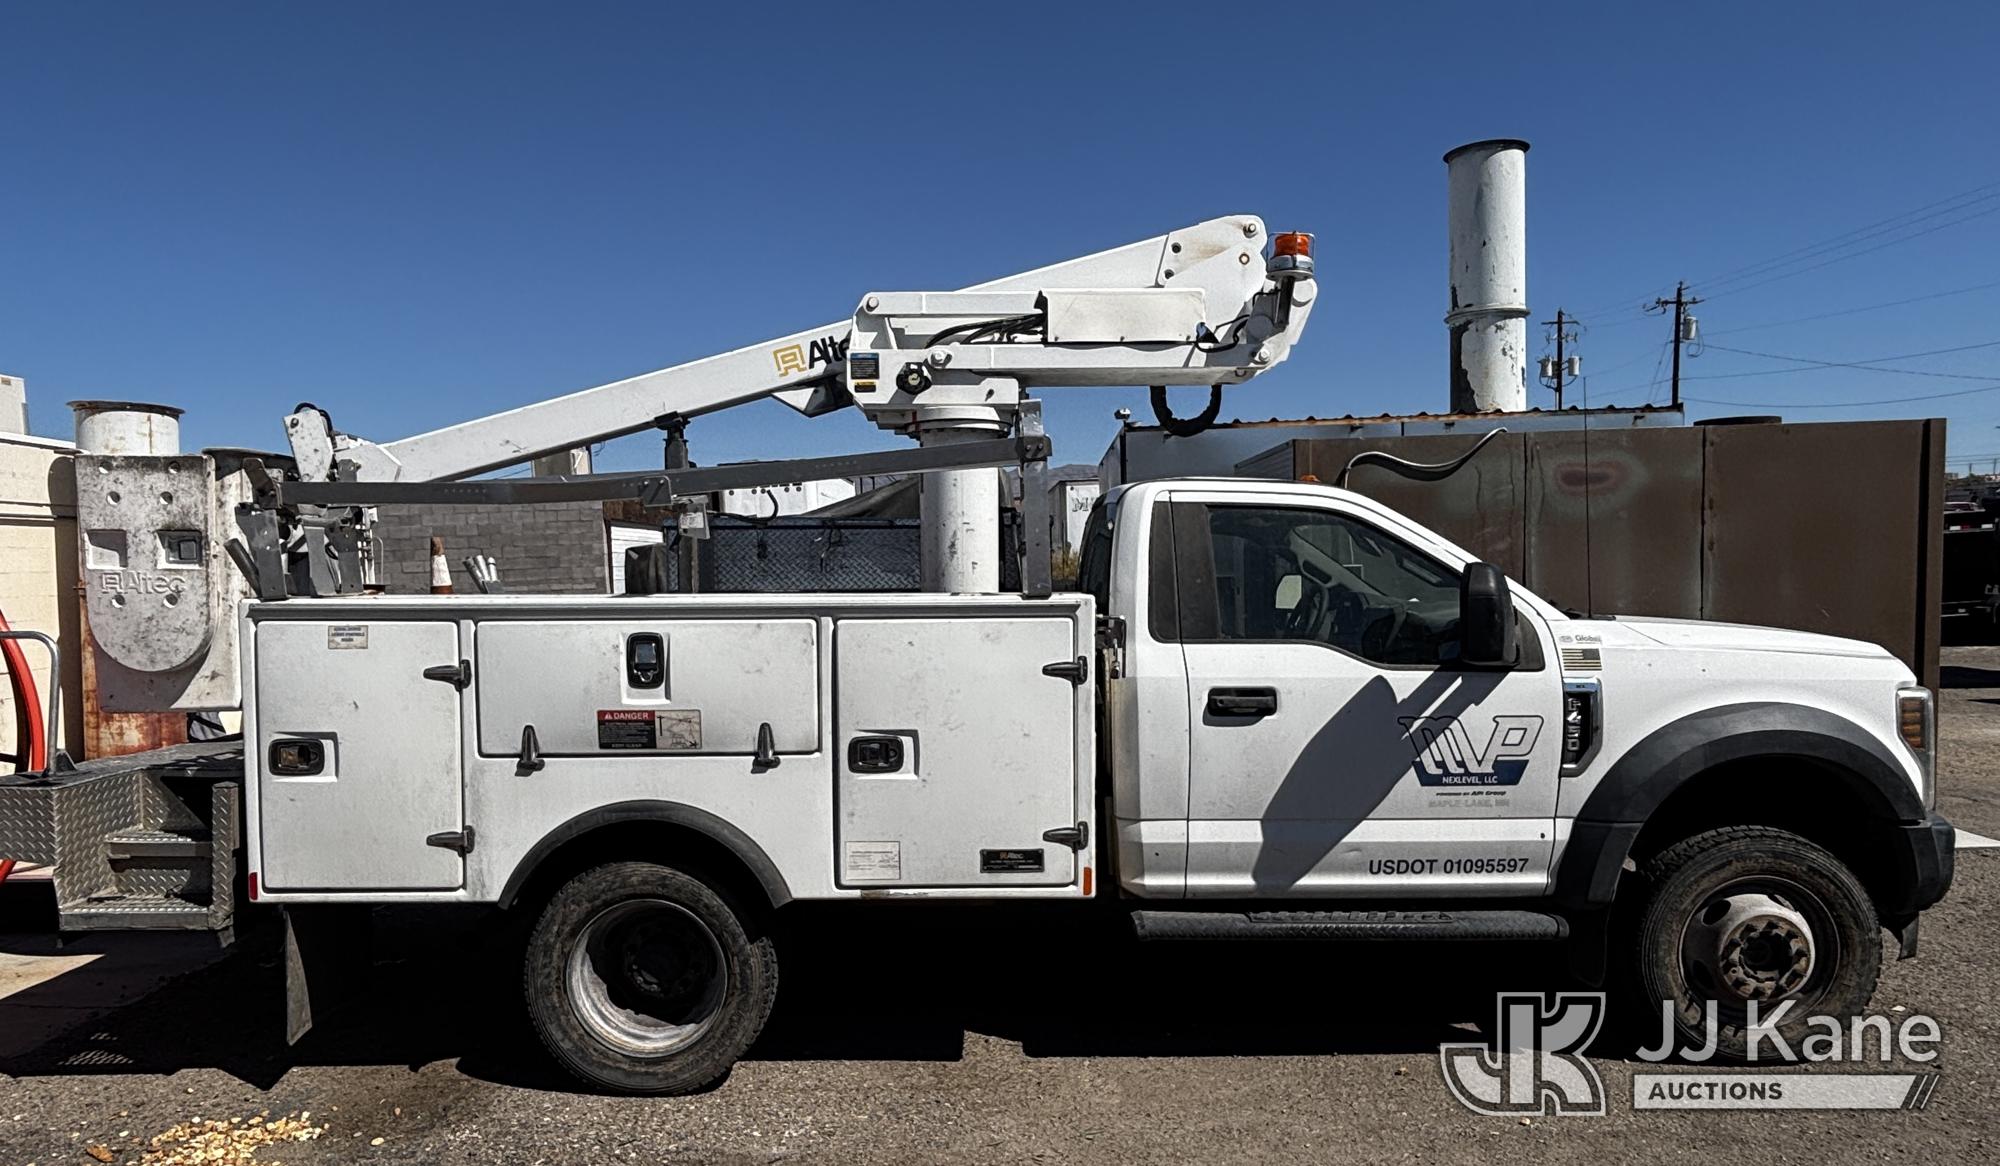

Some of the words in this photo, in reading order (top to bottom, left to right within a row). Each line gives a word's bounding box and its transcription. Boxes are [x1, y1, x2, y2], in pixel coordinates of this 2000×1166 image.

[808, 335, 851, 369] Alte
[125, 570, 187, 595] Altec
[613, 712, 649, 720] DANGER
[1442, 775, 1482, 785] NEXLEVEL,
[1484, 775, 1498, 784] LLC
[1368, 858, 1438, 875] USDOT
[1443, 858, 1529, 874] 01095597
